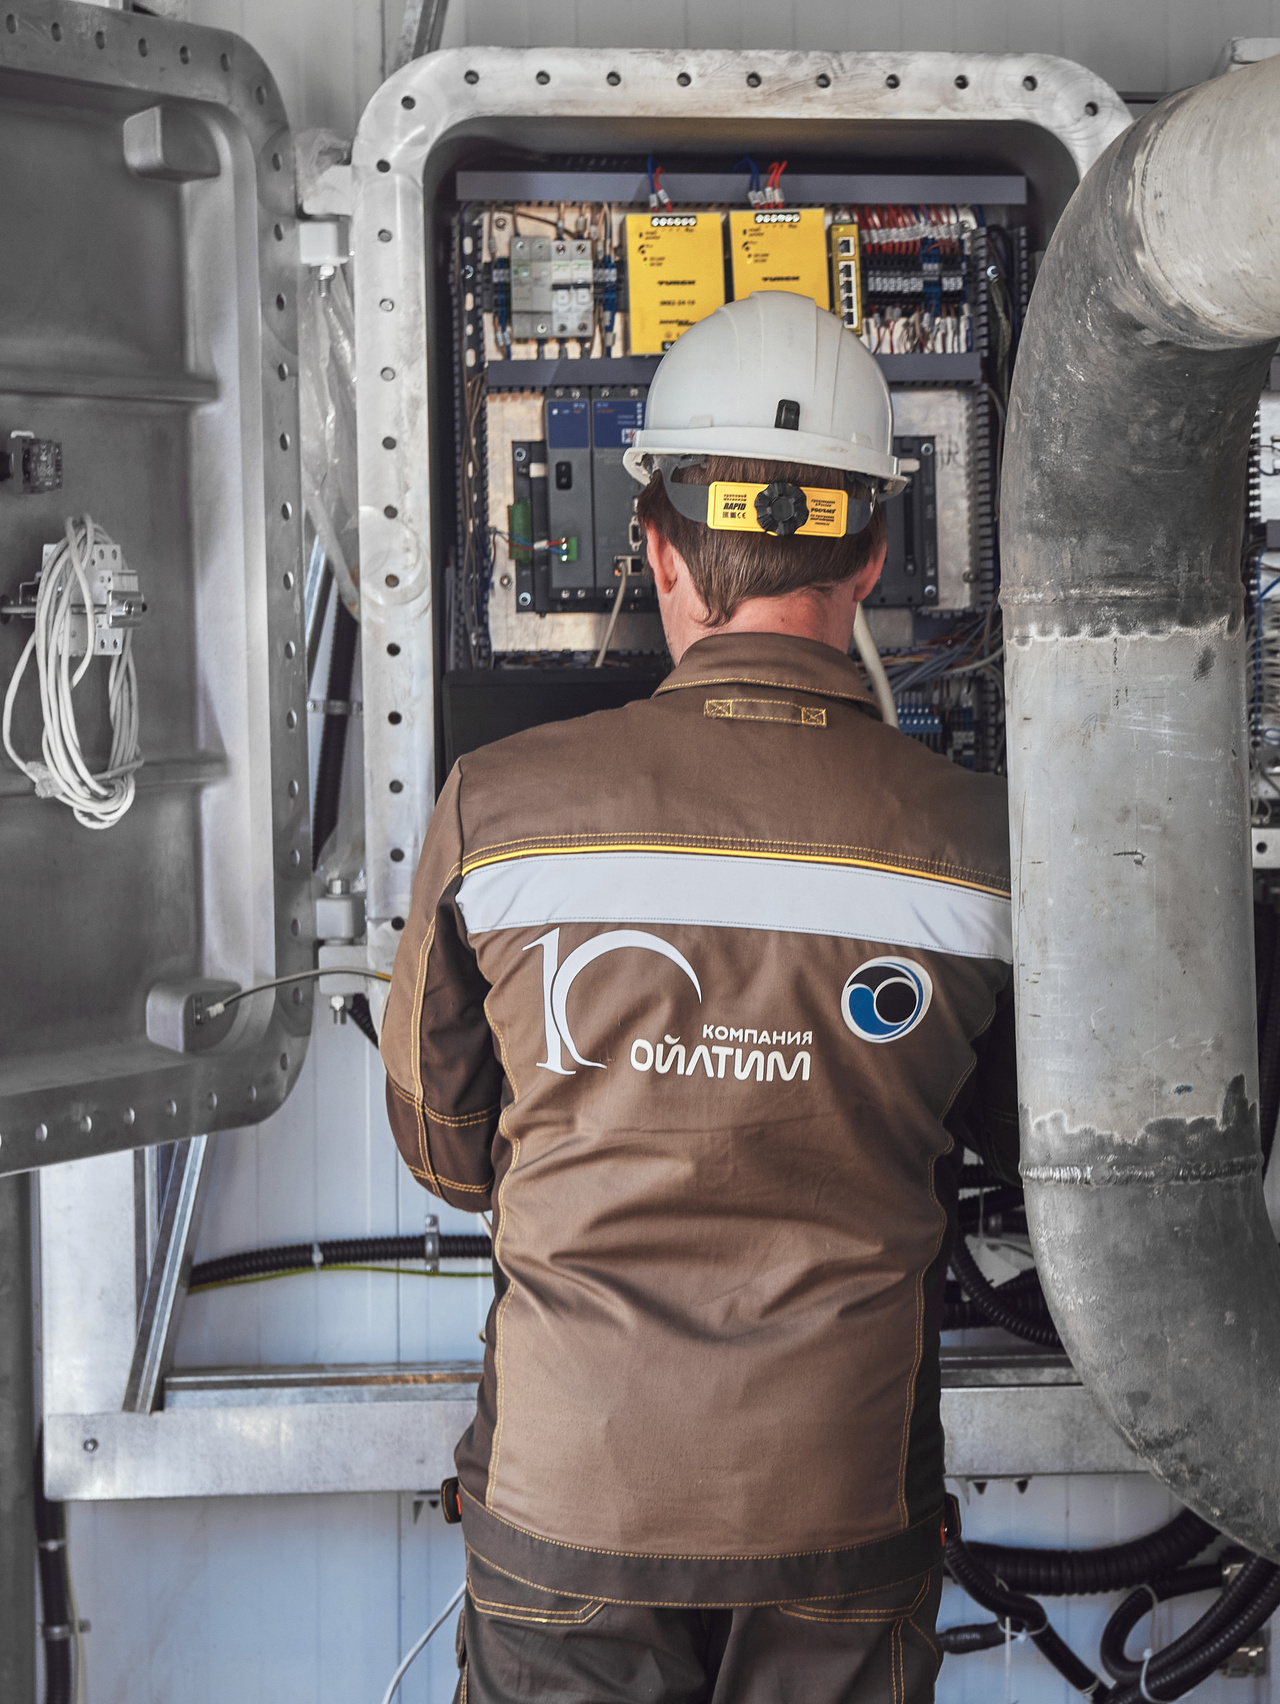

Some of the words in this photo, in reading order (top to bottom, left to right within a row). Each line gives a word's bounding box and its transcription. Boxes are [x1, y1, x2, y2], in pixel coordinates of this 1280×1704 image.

[723, 502, 747, 511] RAPID
[702, 1023, 813, 1046] КОМПАНИЯ
[629, 1035, 813, 1082] ОЙЛТИМ
